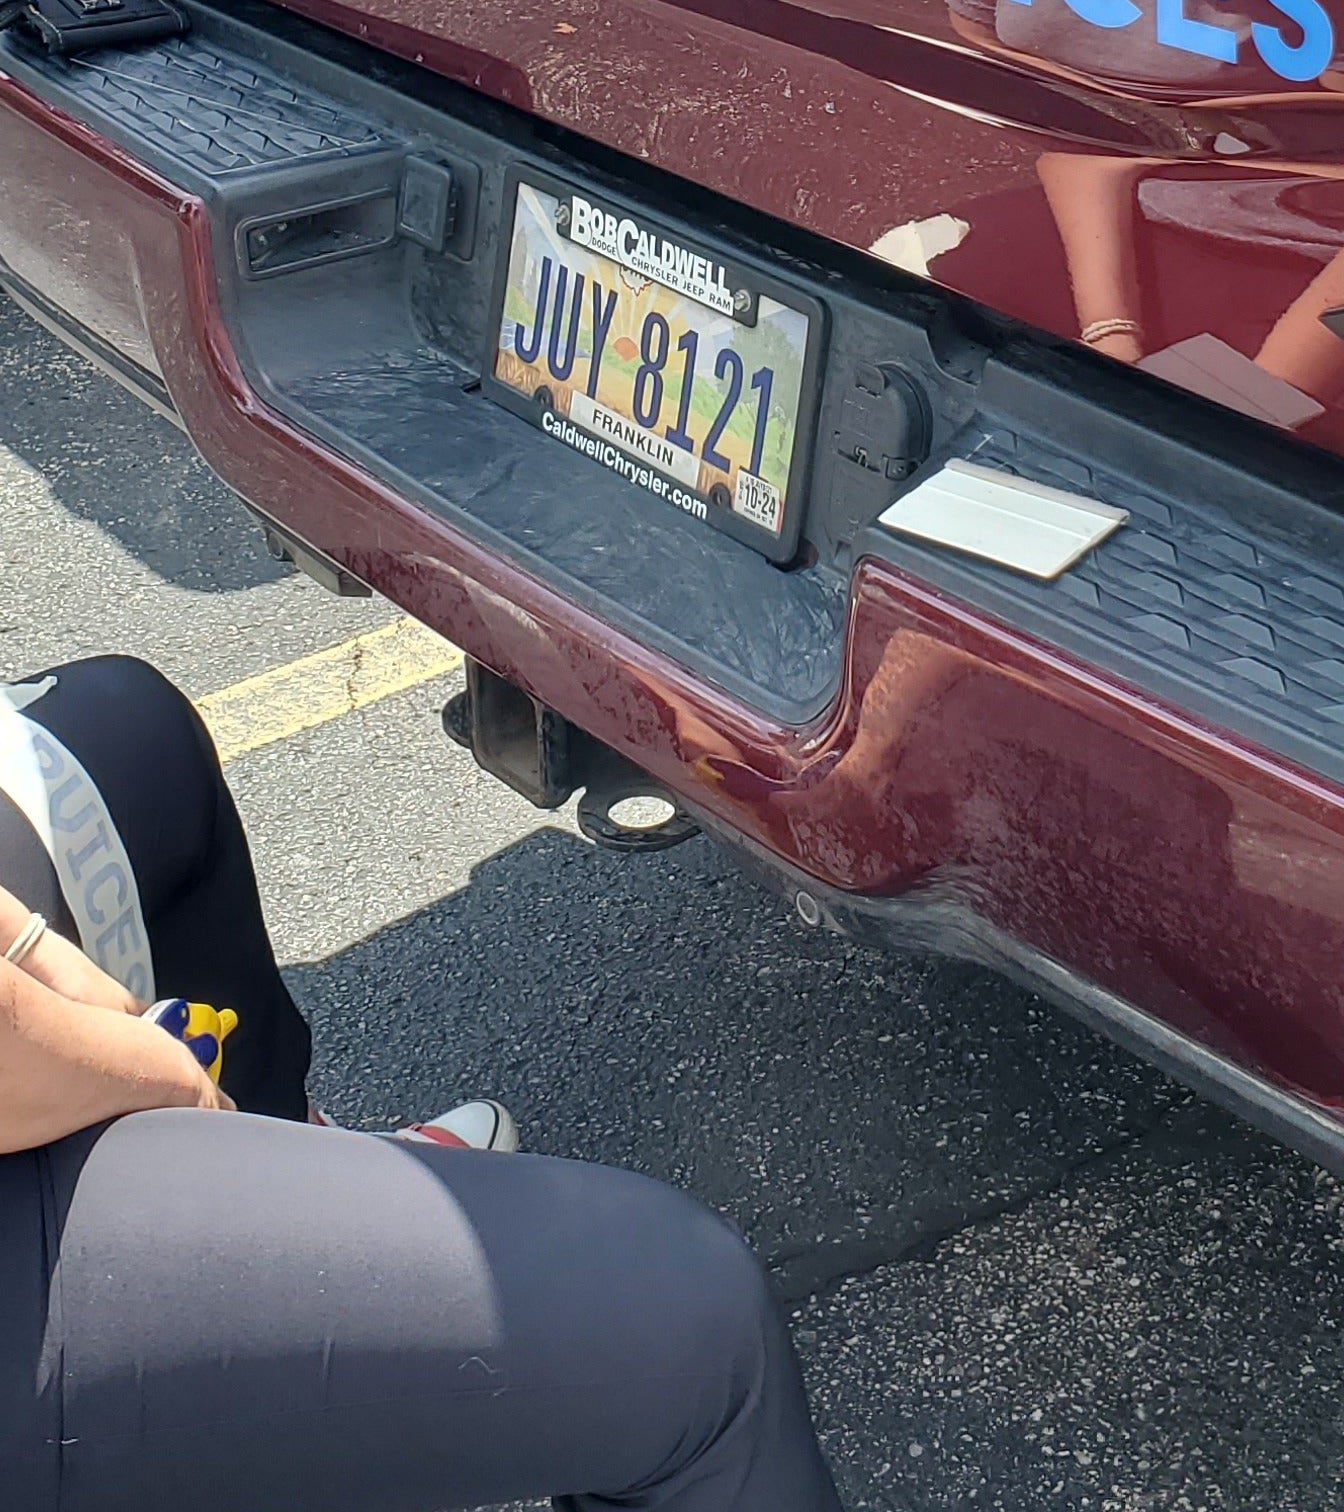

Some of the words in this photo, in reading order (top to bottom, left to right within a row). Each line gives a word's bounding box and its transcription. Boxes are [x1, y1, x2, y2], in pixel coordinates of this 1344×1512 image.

[591, 237, 617, 256] DODGE
[631, 256, 679, 286] CHRYSLER
[682, 279, 705, 298] JEEP
[708, 292, 732, 311] RAM
[514, 255, 619, 400] JUY
[632, 311, 775, 481] 8121
[541, 411, 708, 520] CaldwellChrysler.com
[592, 408, 675, 467] FRANKLIN
[744, 483, 776, 519] 10-24
